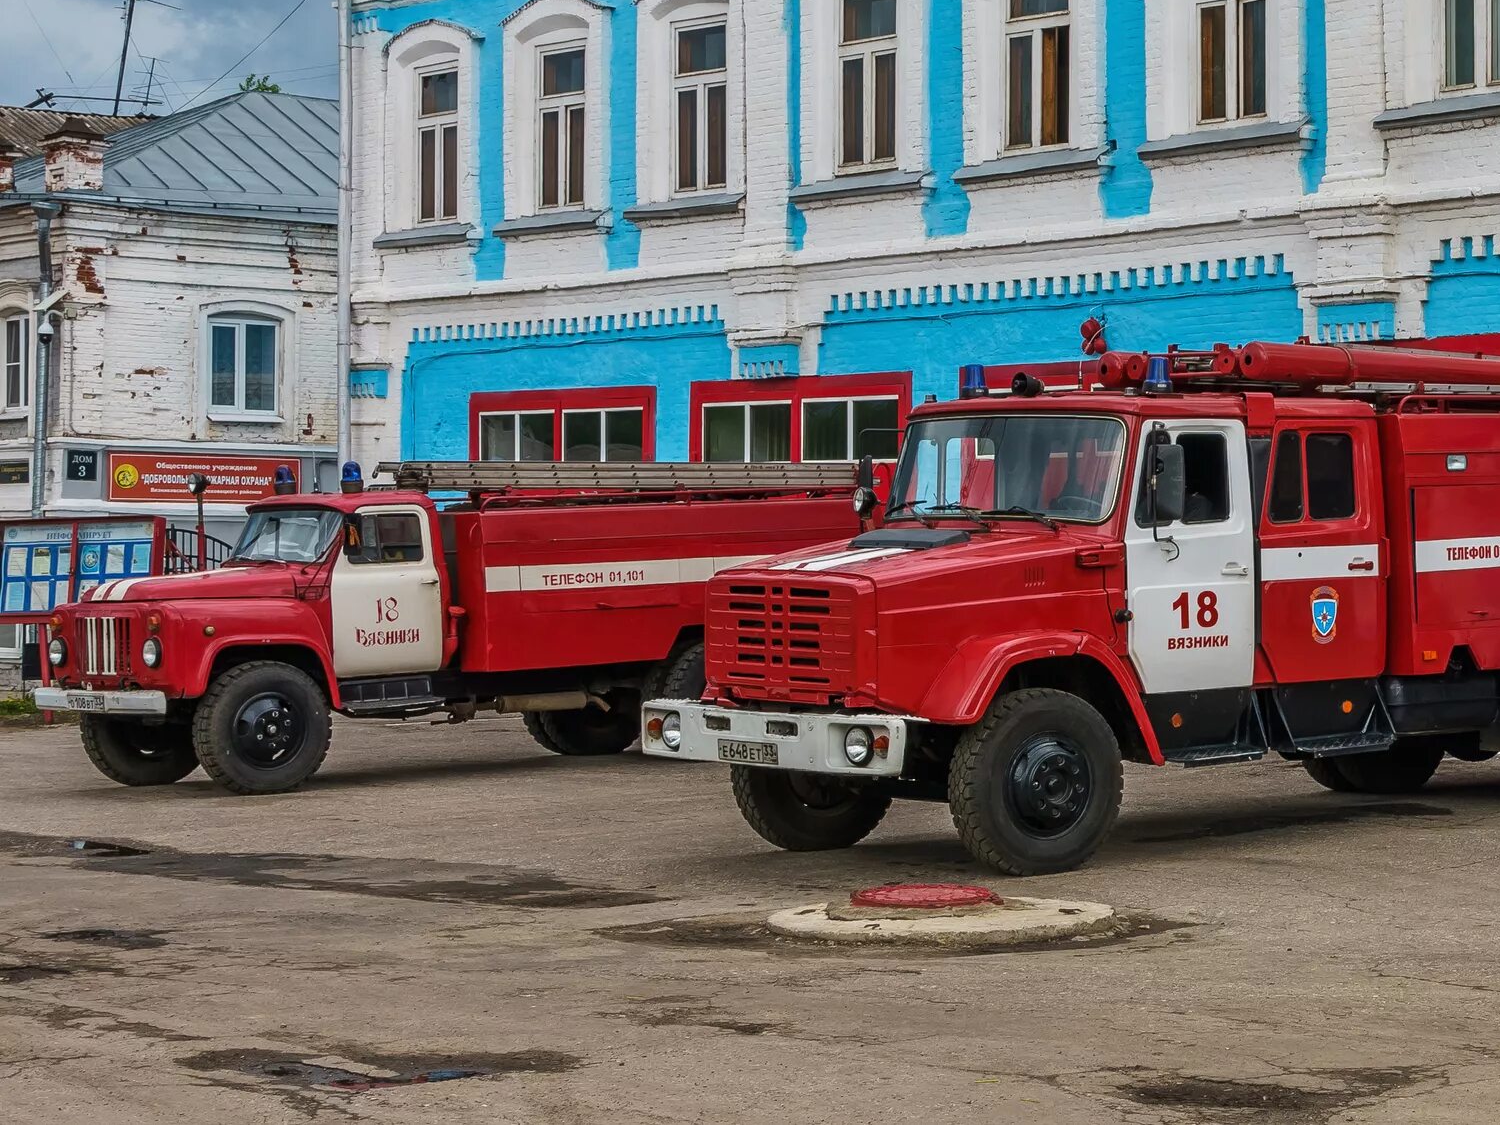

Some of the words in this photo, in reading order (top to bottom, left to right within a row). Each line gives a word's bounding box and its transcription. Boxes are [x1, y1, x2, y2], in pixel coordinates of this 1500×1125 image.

[72, 455, 93, 464] ДОМ
[78, 465, 86, 477] 3
[155, 461, 211, 470] Общественное
[212, 464, 258, 472] учреждение
[141, 474, 189, 485] "ДОБРОВОЛЬ
[206, 475, 240, 485] ОЖАРНАЯ
[46, 531, 112, 541] ИНФОМИРУЕТ
[1446, 545, 1491, 561] ТЕЛЕФОН
[542, 572, 604, 586] ТЕЛЕФОН
[609, 570, 645, 583] 01,101
[375, 596, 400, 624] 18
[1172, 590, 1219, 630] 18
[1167, 635, 1229, 650] ВЯЗНИКИ
